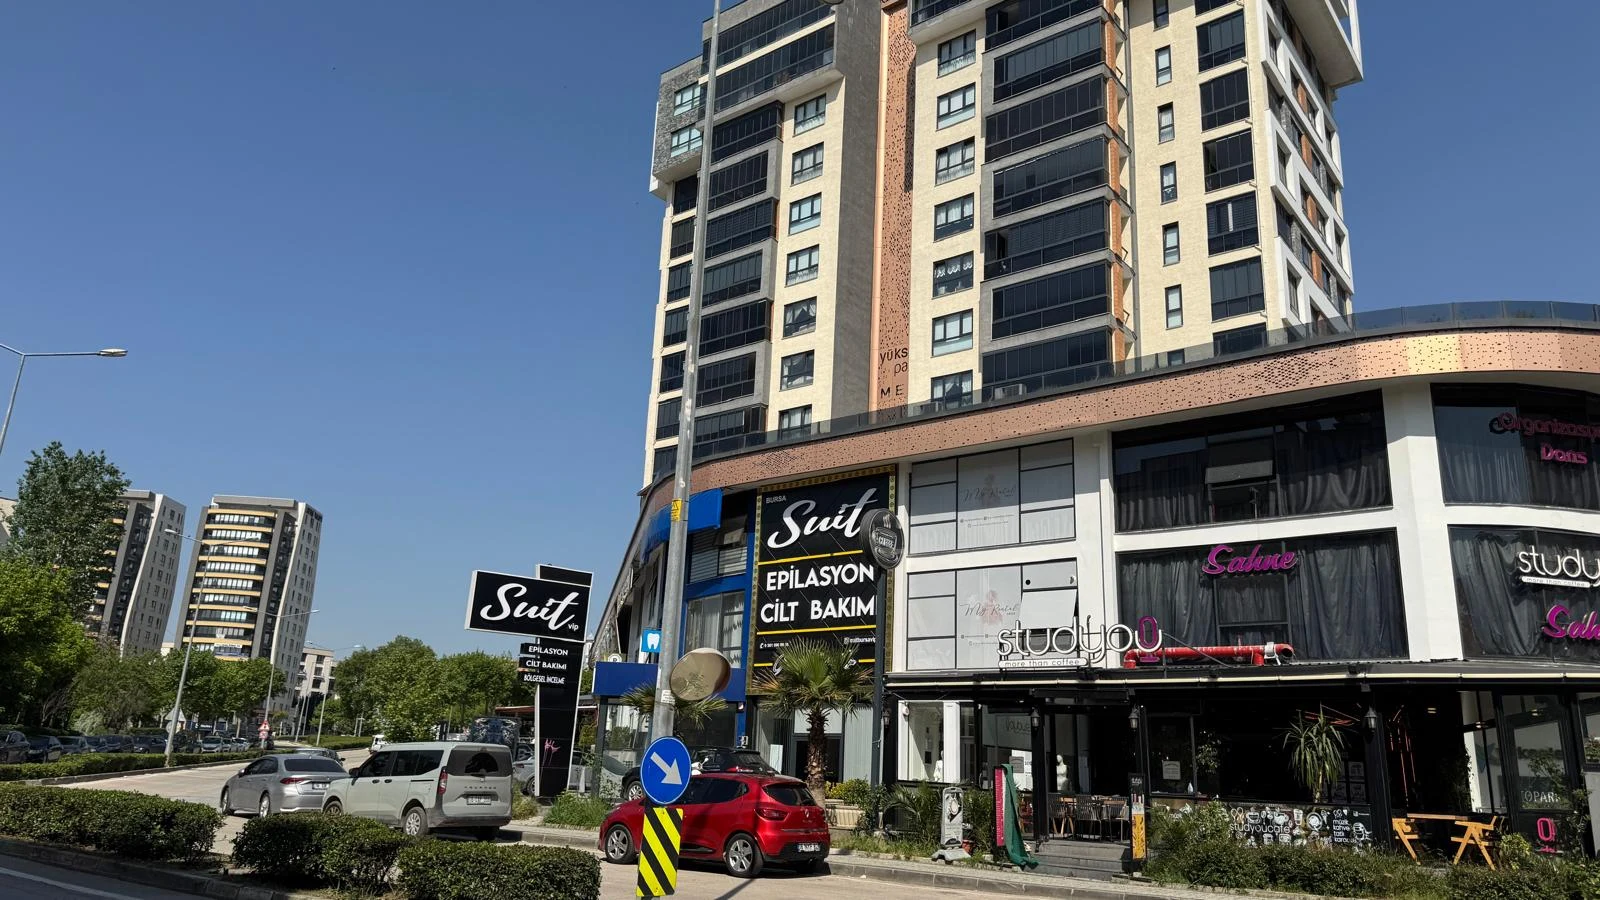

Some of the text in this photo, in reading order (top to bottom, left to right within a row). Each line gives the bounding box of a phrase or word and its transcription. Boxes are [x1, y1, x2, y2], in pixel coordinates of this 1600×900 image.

[765, 495, 787, 504] BURSA
[766, 487, 879, 549] Suit
[766, 562, 875, 592] EPİLASYON
[479, 583, 579, 631] Suit
[760, 598, 799, 624] CİLT
[997, 614, 1163, 664] studyou
[525, 659, 567, 670] CİLT BAKIMI
[1004, 657, 1080, 668] more than coffee
[523, 673, 546, 683] BÖLGESEL
[1229, 821, 1291, 835] studyoucafe
